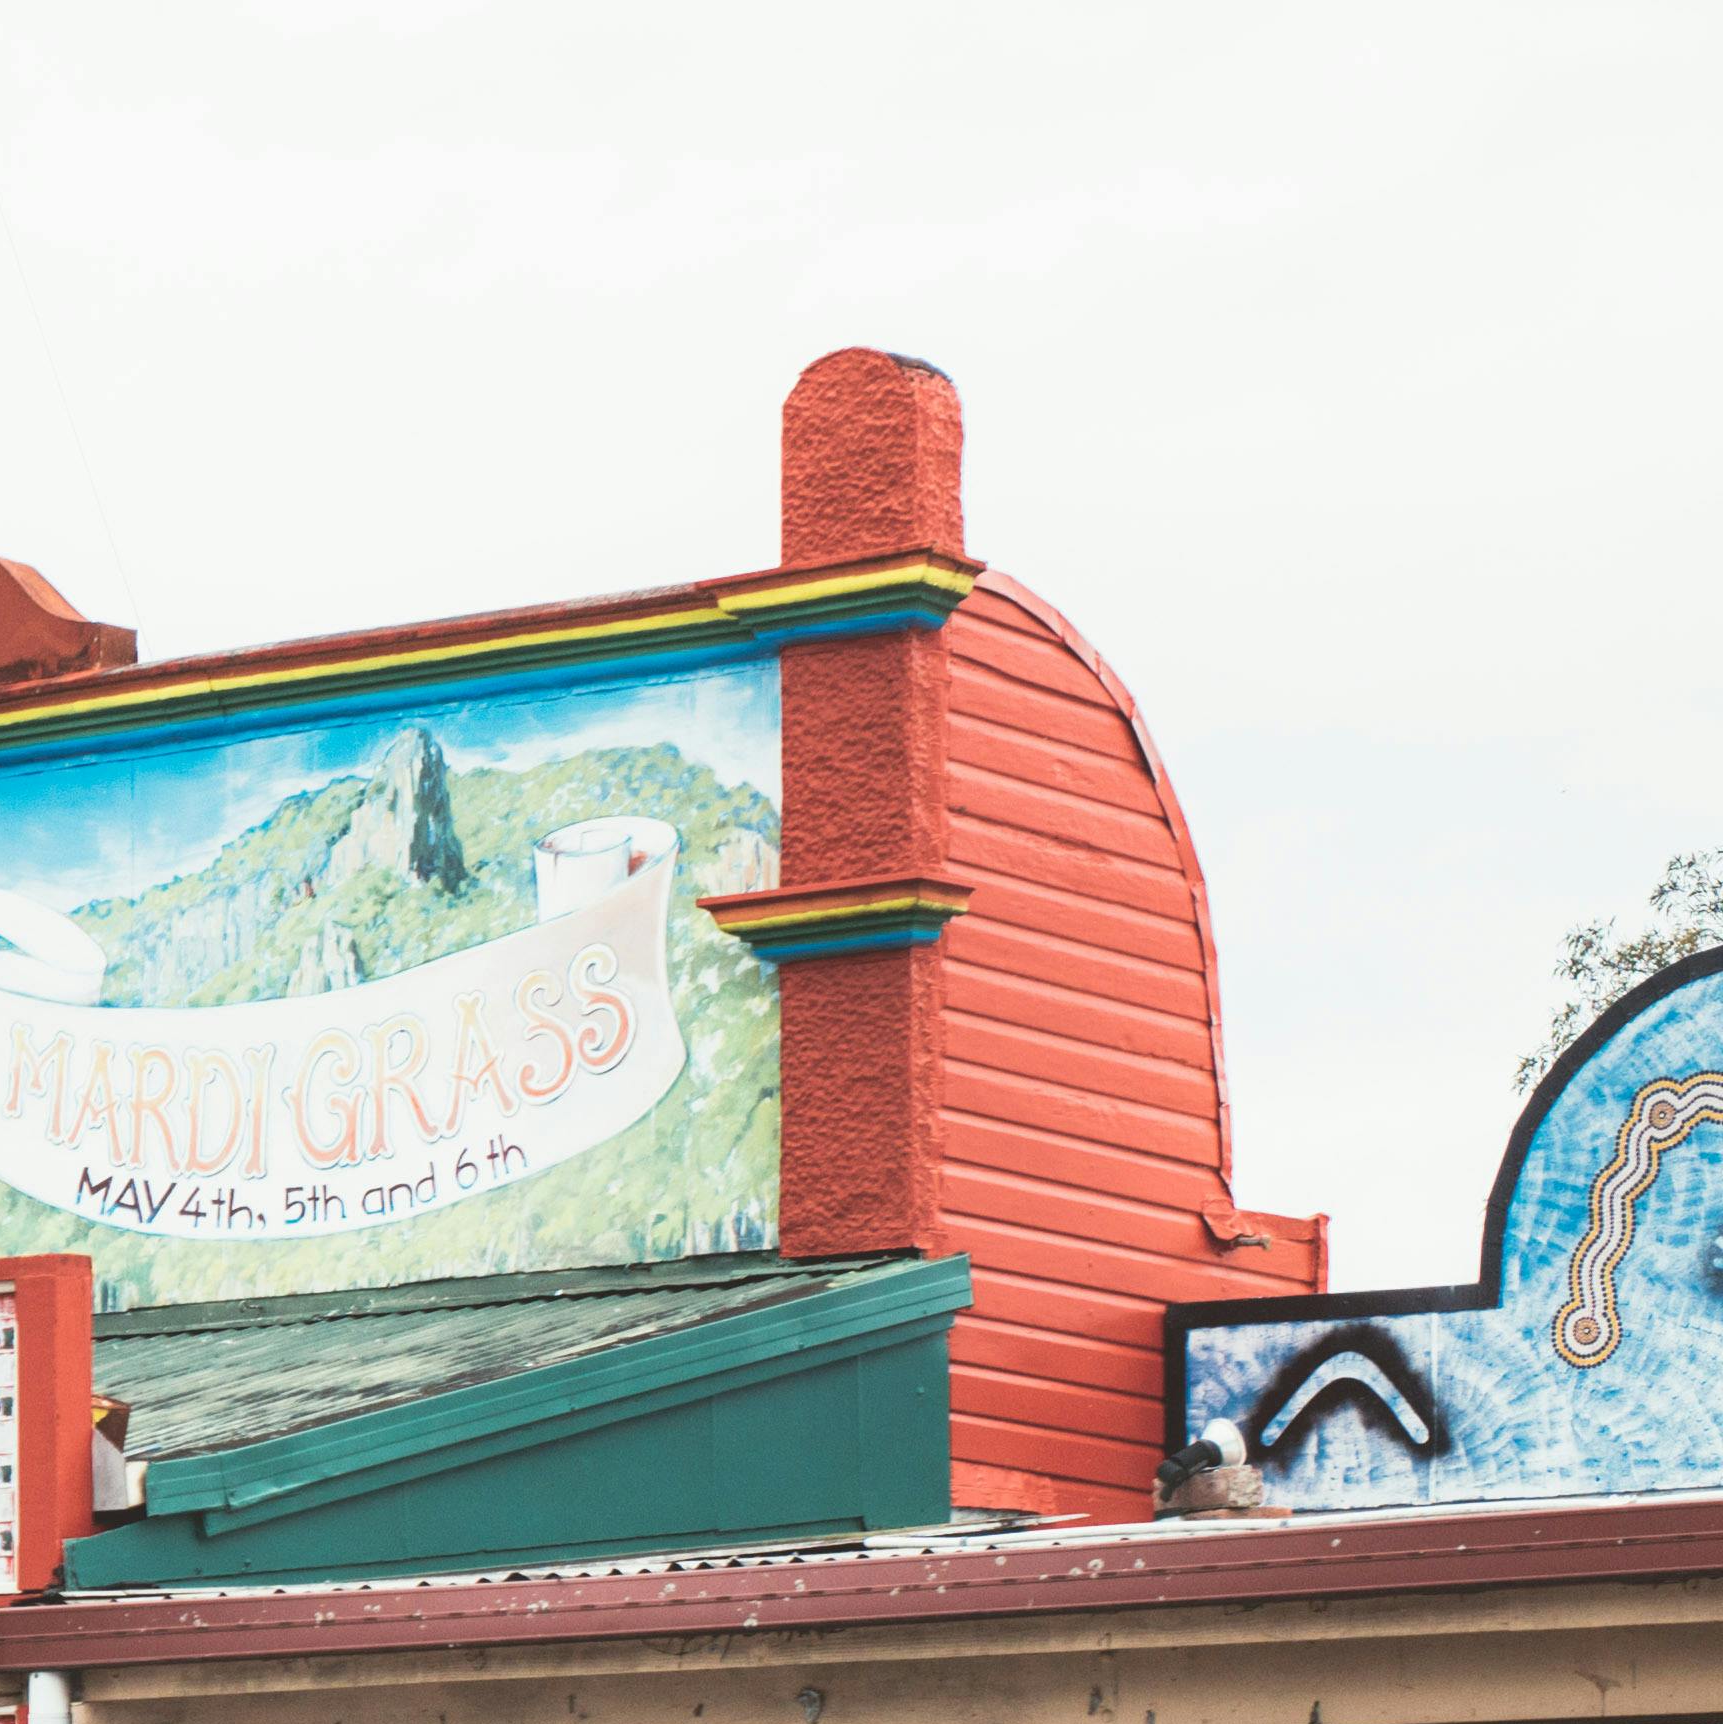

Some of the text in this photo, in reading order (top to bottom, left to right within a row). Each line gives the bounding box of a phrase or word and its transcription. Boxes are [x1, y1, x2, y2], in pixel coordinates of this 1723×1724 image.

[4, 942, 638, 1179] MARDI GRASS
[76, 1166, 177, 1224] MAY
[178, 1186, 266, 1230] 4th,
[284, 1184, 347, 1223] 5th
[361, 1161, 436, 1216] and
